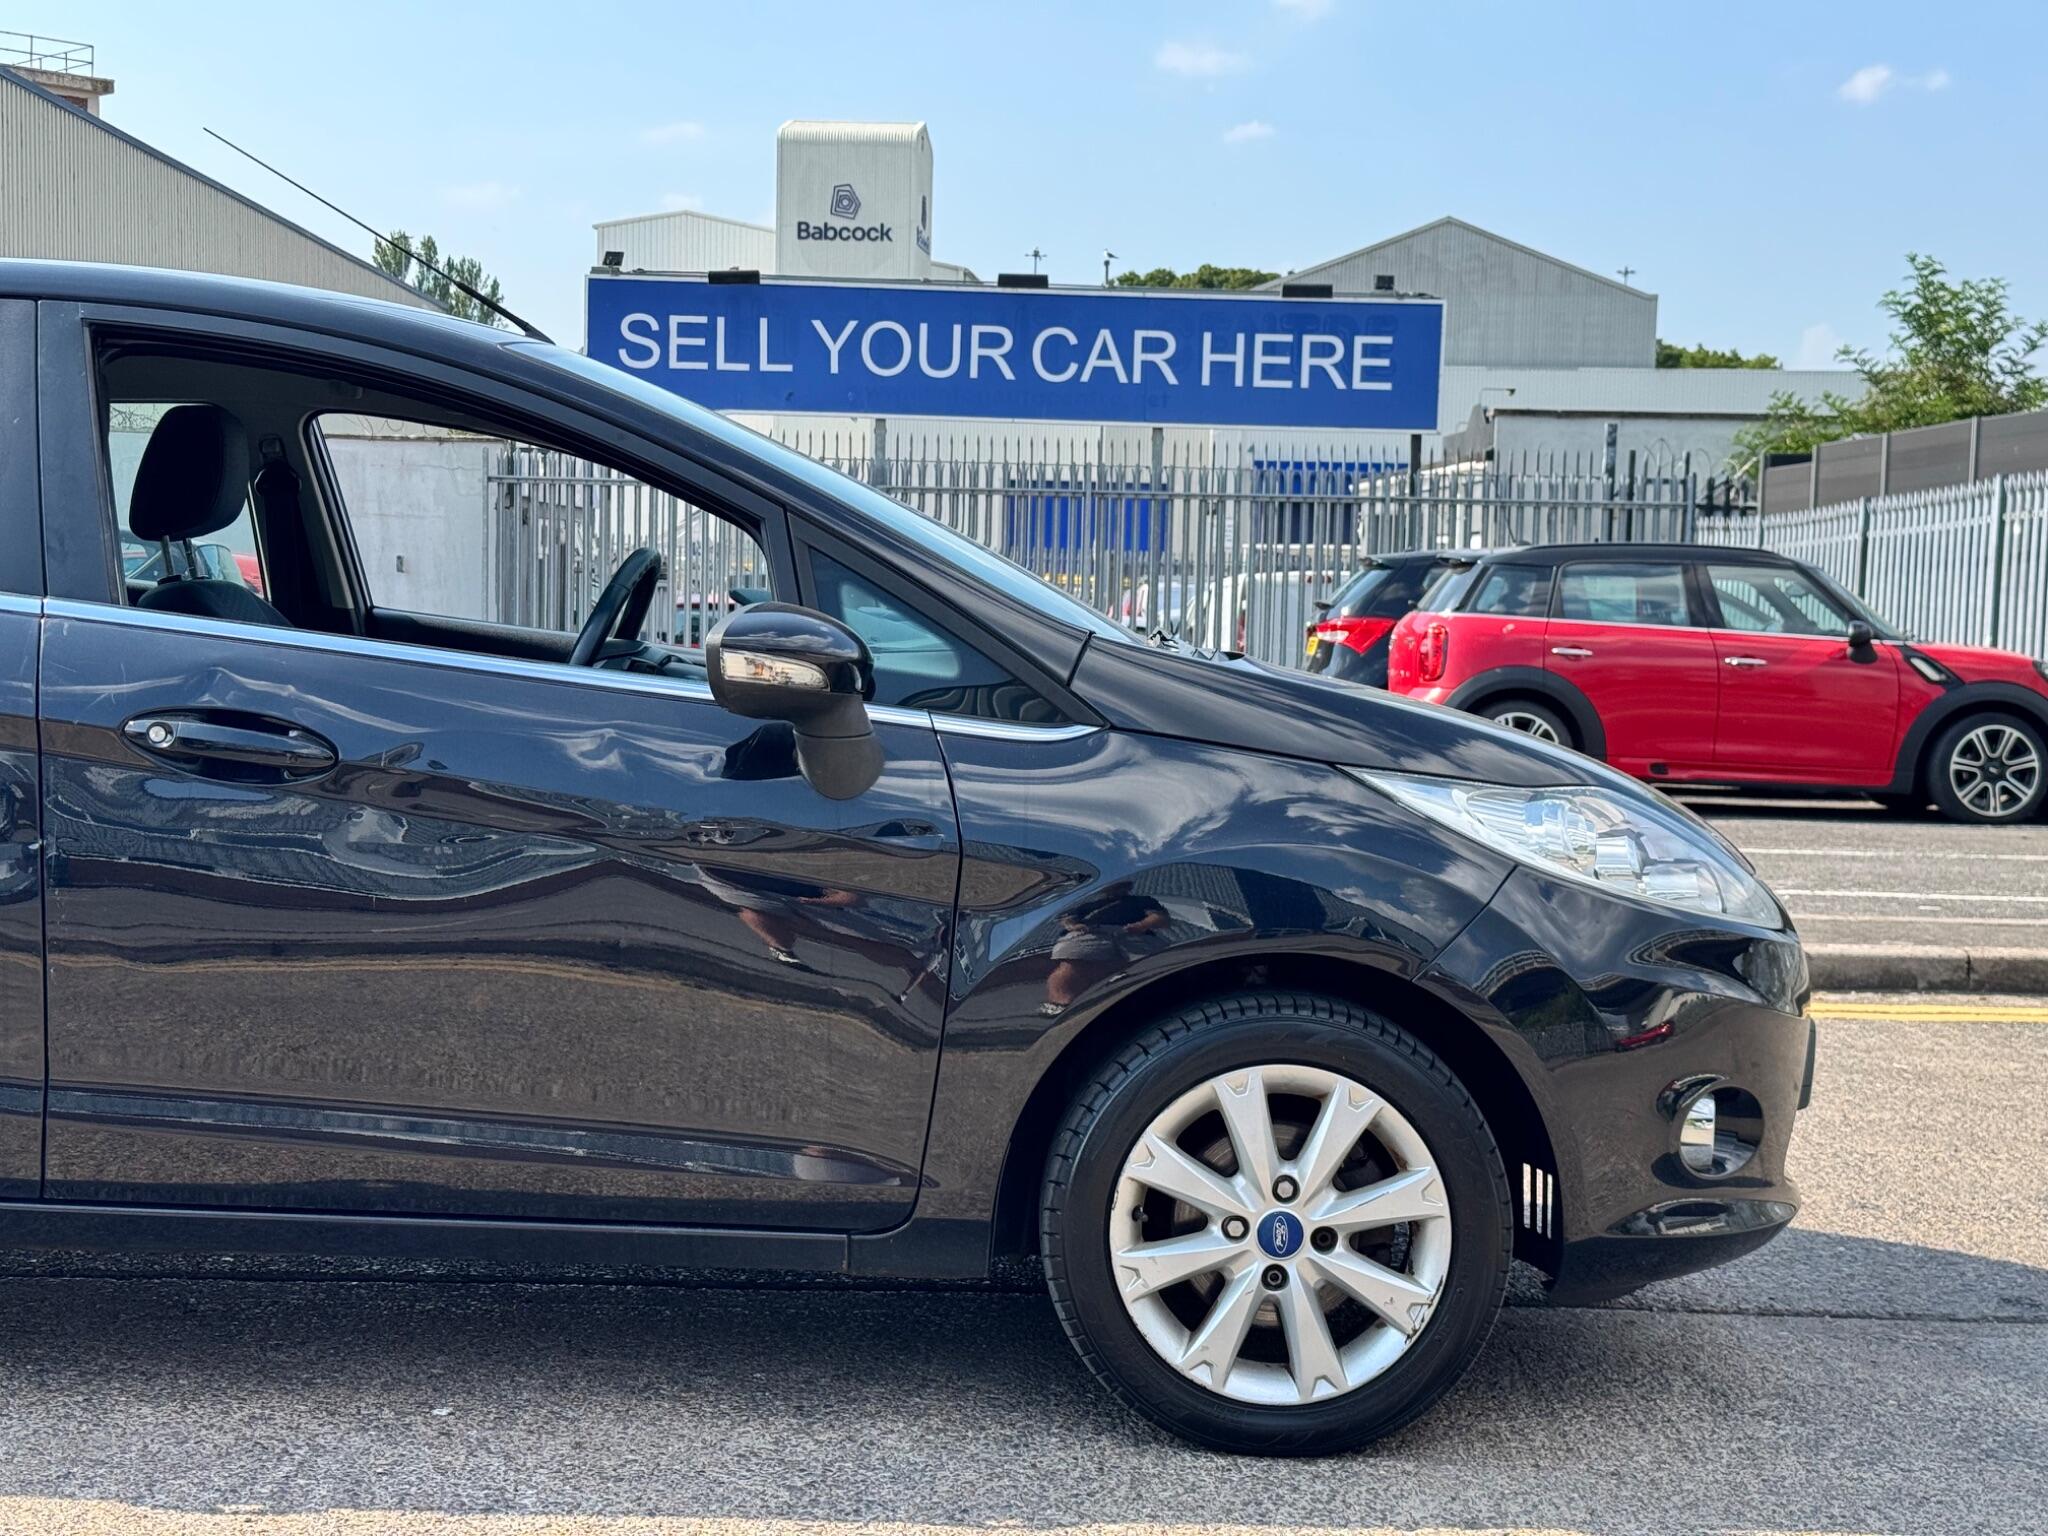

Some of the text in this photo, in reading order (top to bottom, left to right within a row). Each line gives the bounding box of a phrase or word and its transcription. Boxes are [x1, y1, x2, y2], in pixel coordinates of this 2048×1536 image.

[797, 220, 893, 242] Babcock
[618, 313, 1392, 390] SELL YOUR CAR HERE
